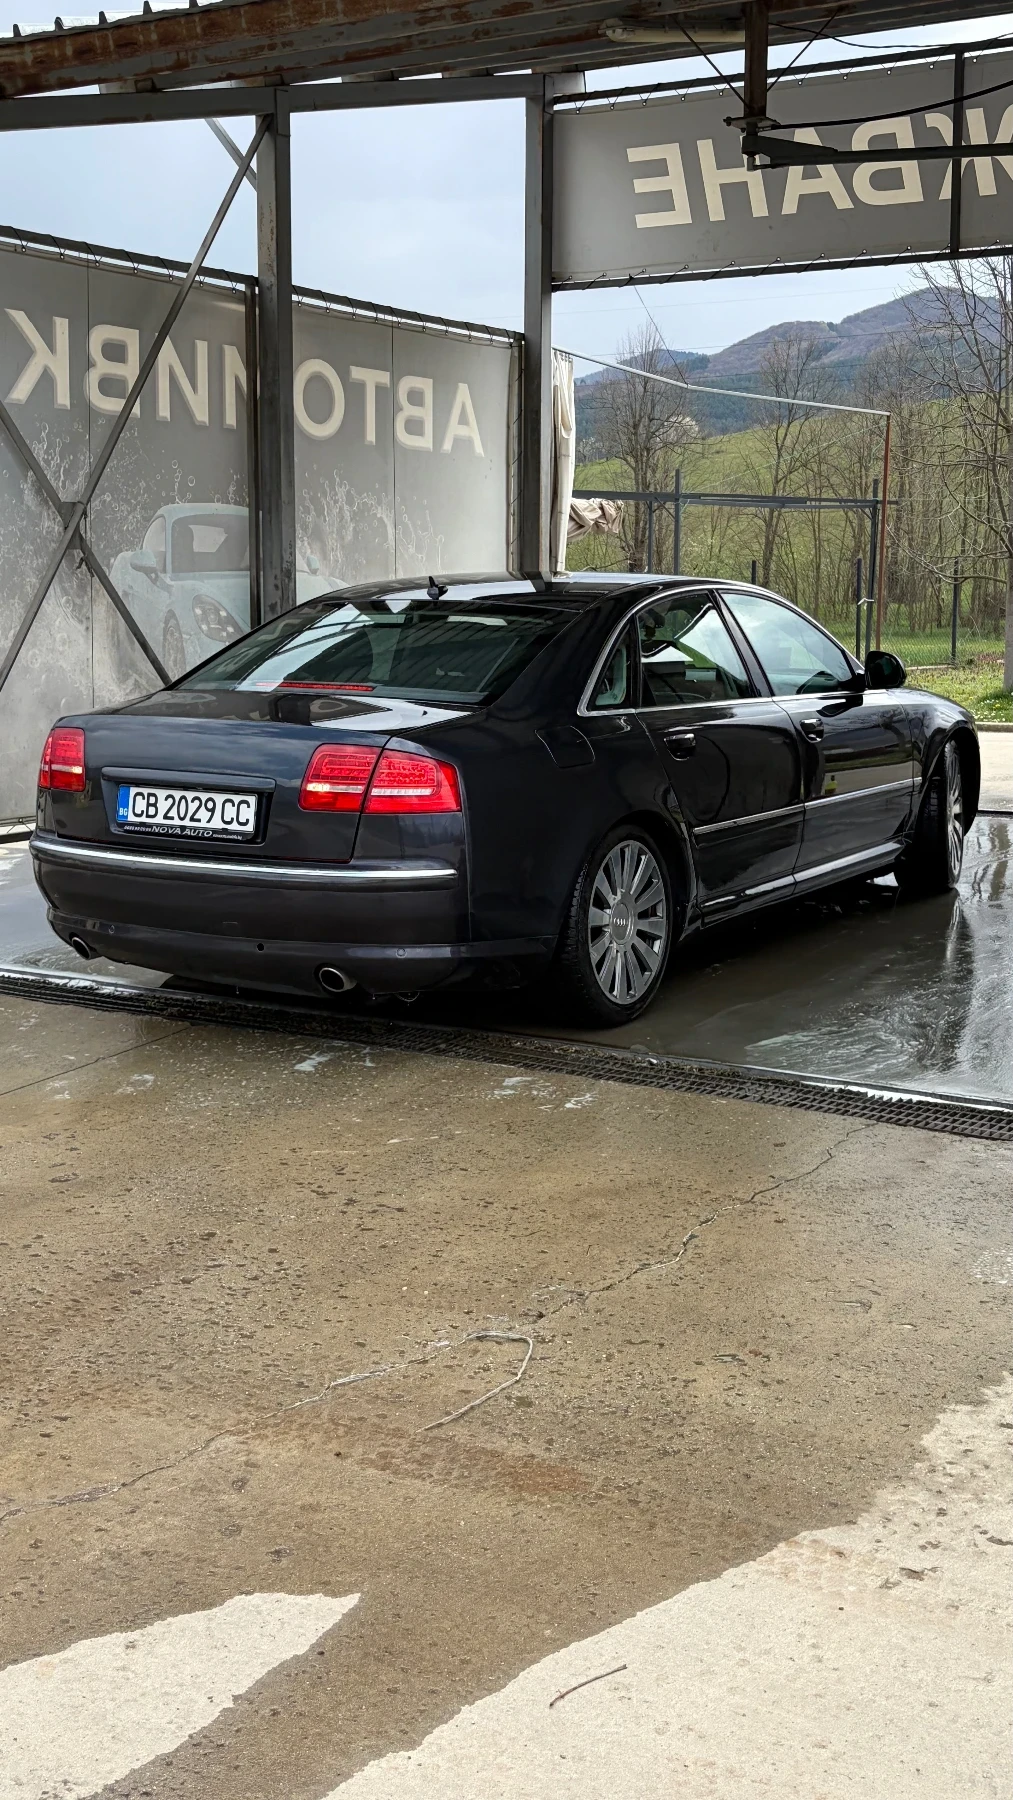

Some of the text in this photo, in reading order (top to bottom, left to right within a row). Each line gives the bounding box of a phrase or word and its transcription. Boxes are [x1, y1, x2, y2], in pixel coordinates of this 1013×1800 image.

[118, 808, 128, 816] BG
[132, 792, 250, 826] CB 2029 CC
[151, 826, 181, 835] NOVA
[182, 828, 213, 837] AUTO
